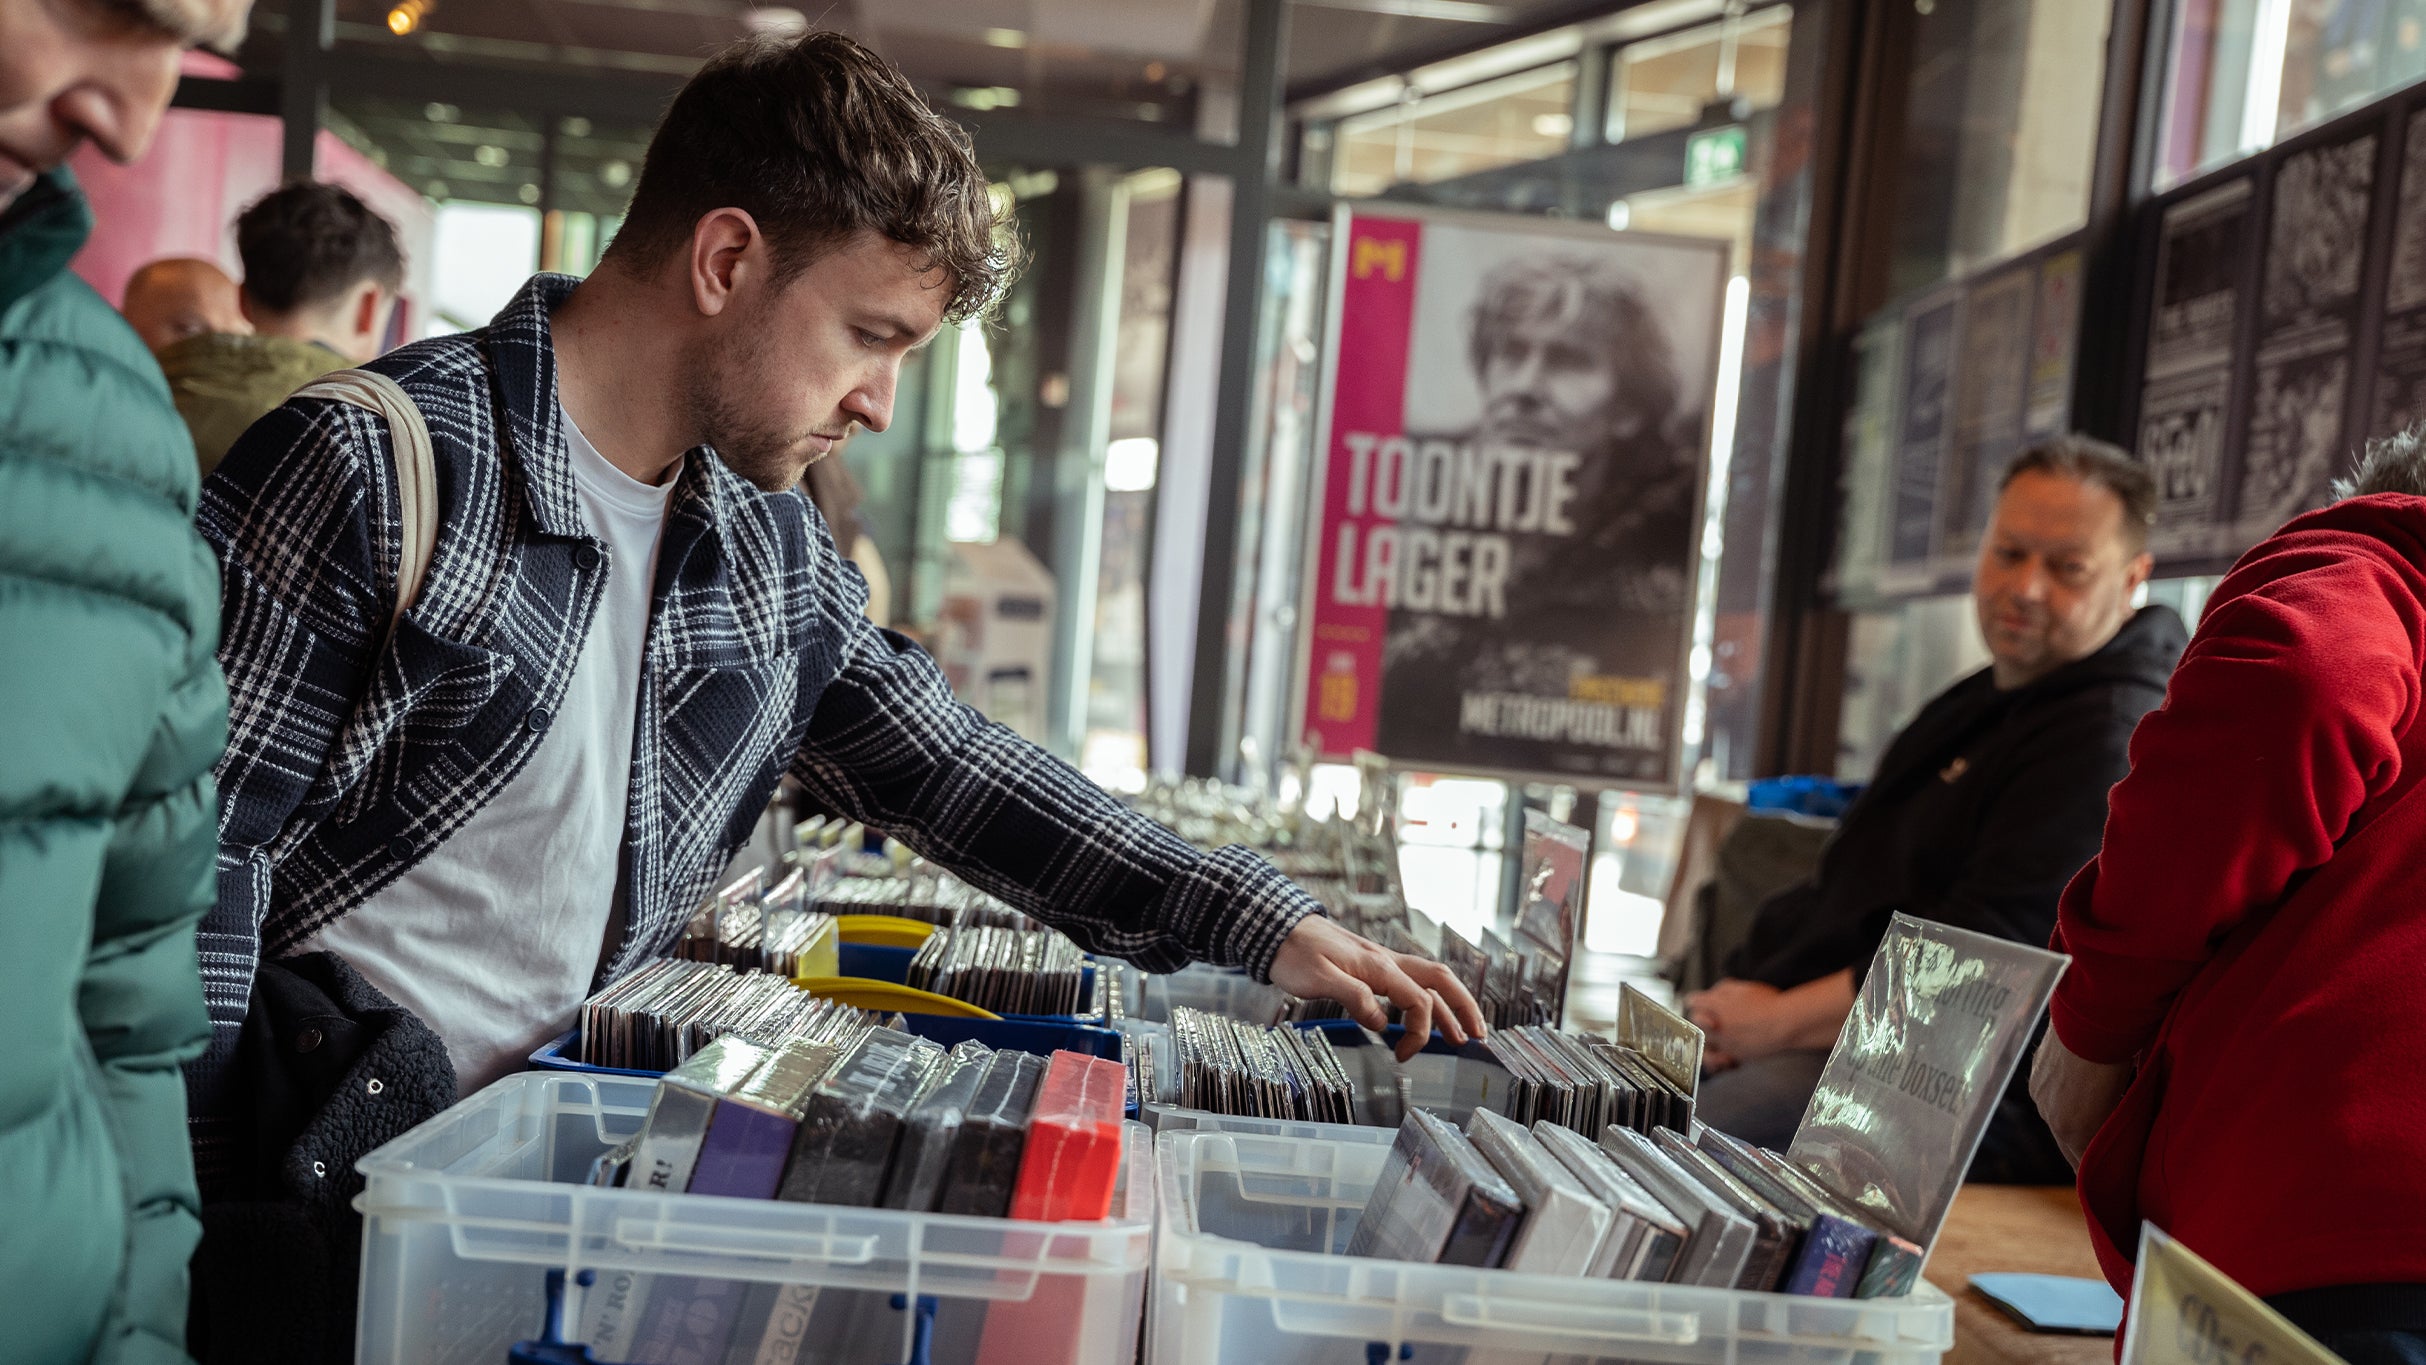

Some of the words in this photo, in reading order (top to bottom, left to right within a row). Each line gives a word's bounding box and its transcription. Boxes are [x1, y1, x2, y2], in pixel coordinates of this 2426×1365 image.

[1342, 433, 1584, 536] TOONTJE
[1332, 524, 1511, 617] LAGER
[1459, 690, 1663, 750] METROPOOL.NL
